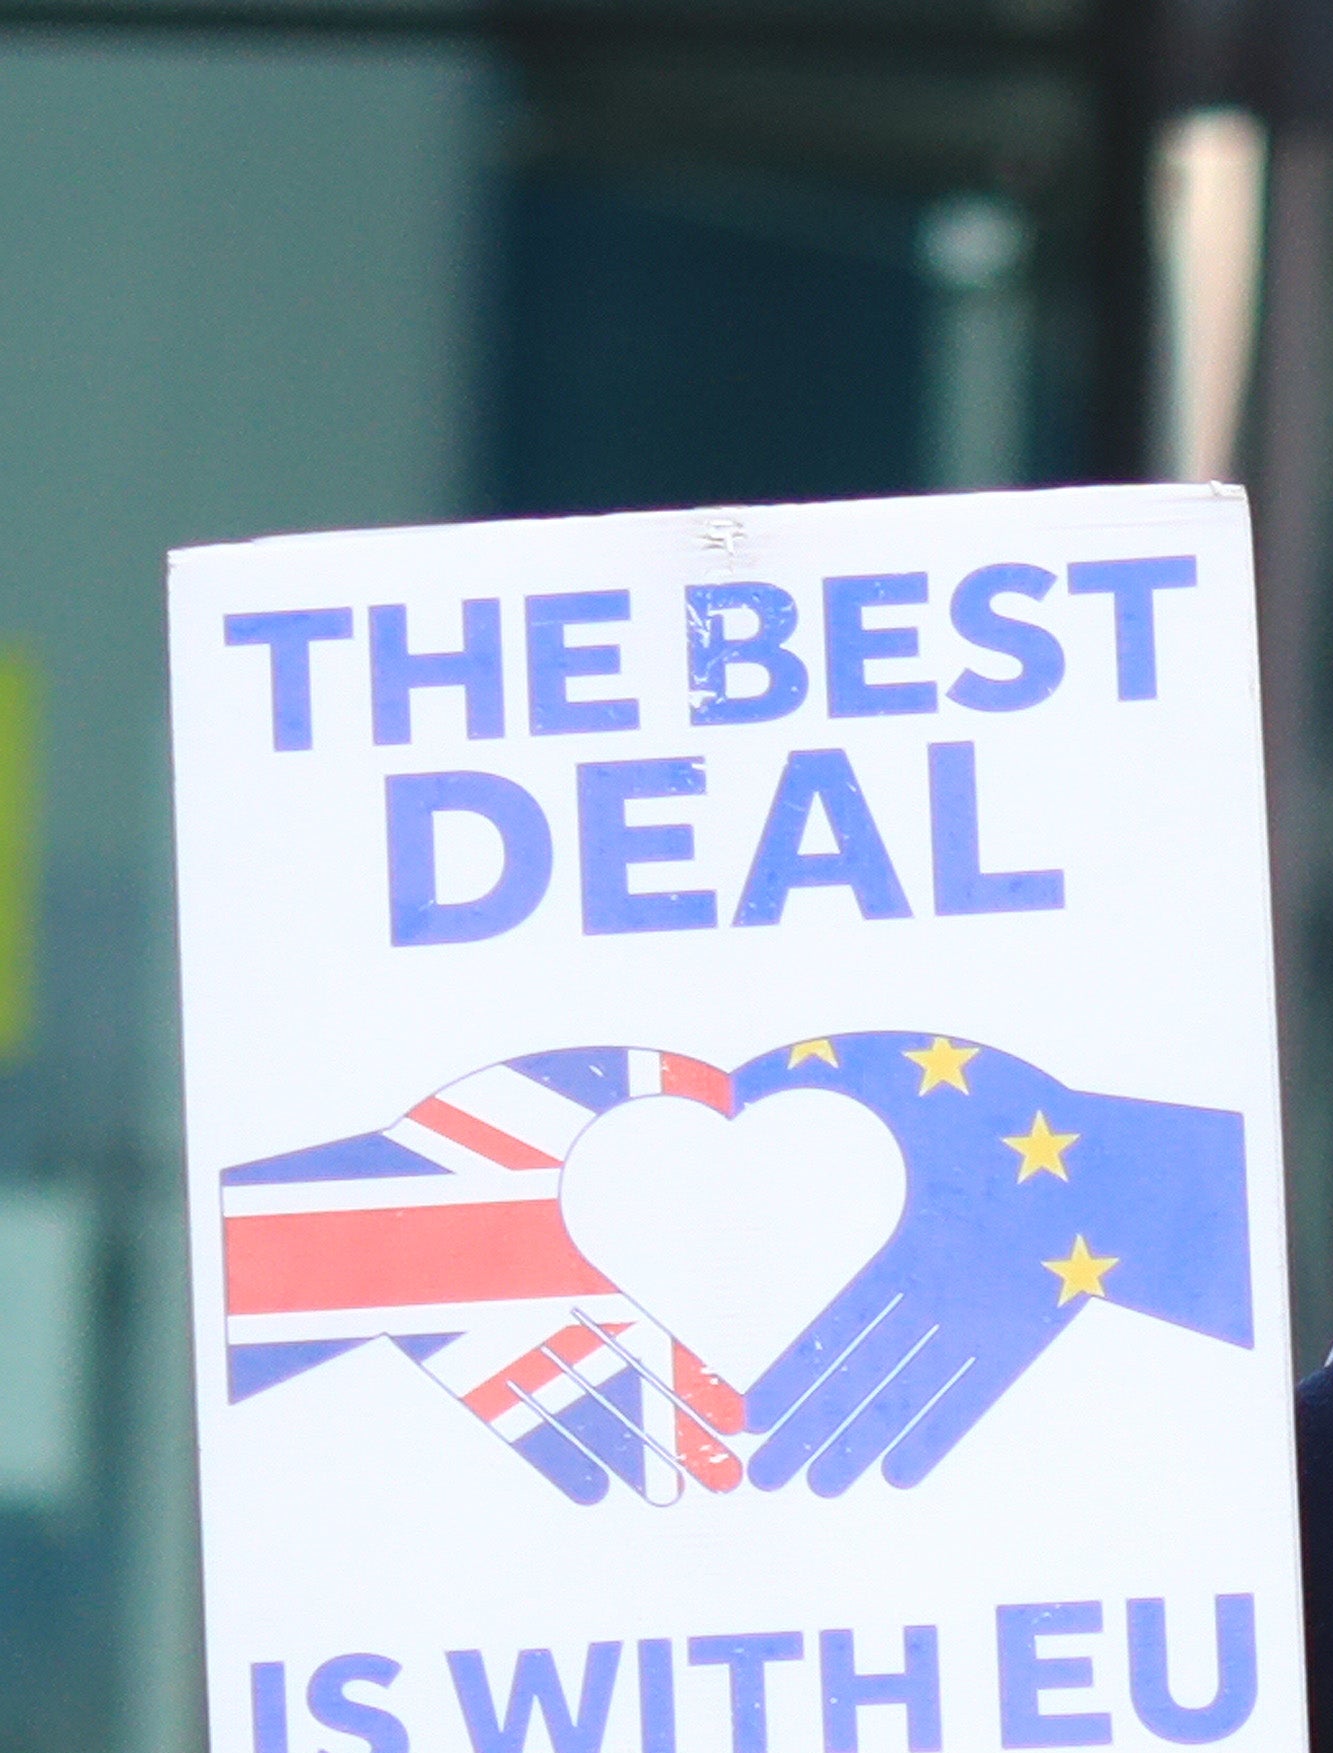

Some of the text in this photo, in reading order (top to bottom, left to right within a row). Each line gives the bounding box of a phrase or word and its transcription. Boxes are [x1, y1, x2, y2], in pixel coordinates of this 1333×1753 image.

[224, 556, 1197, 752] THE BEST
[386, 740, 1065, 948] DEAL
[996, 1593, 1258, 1749] EU
